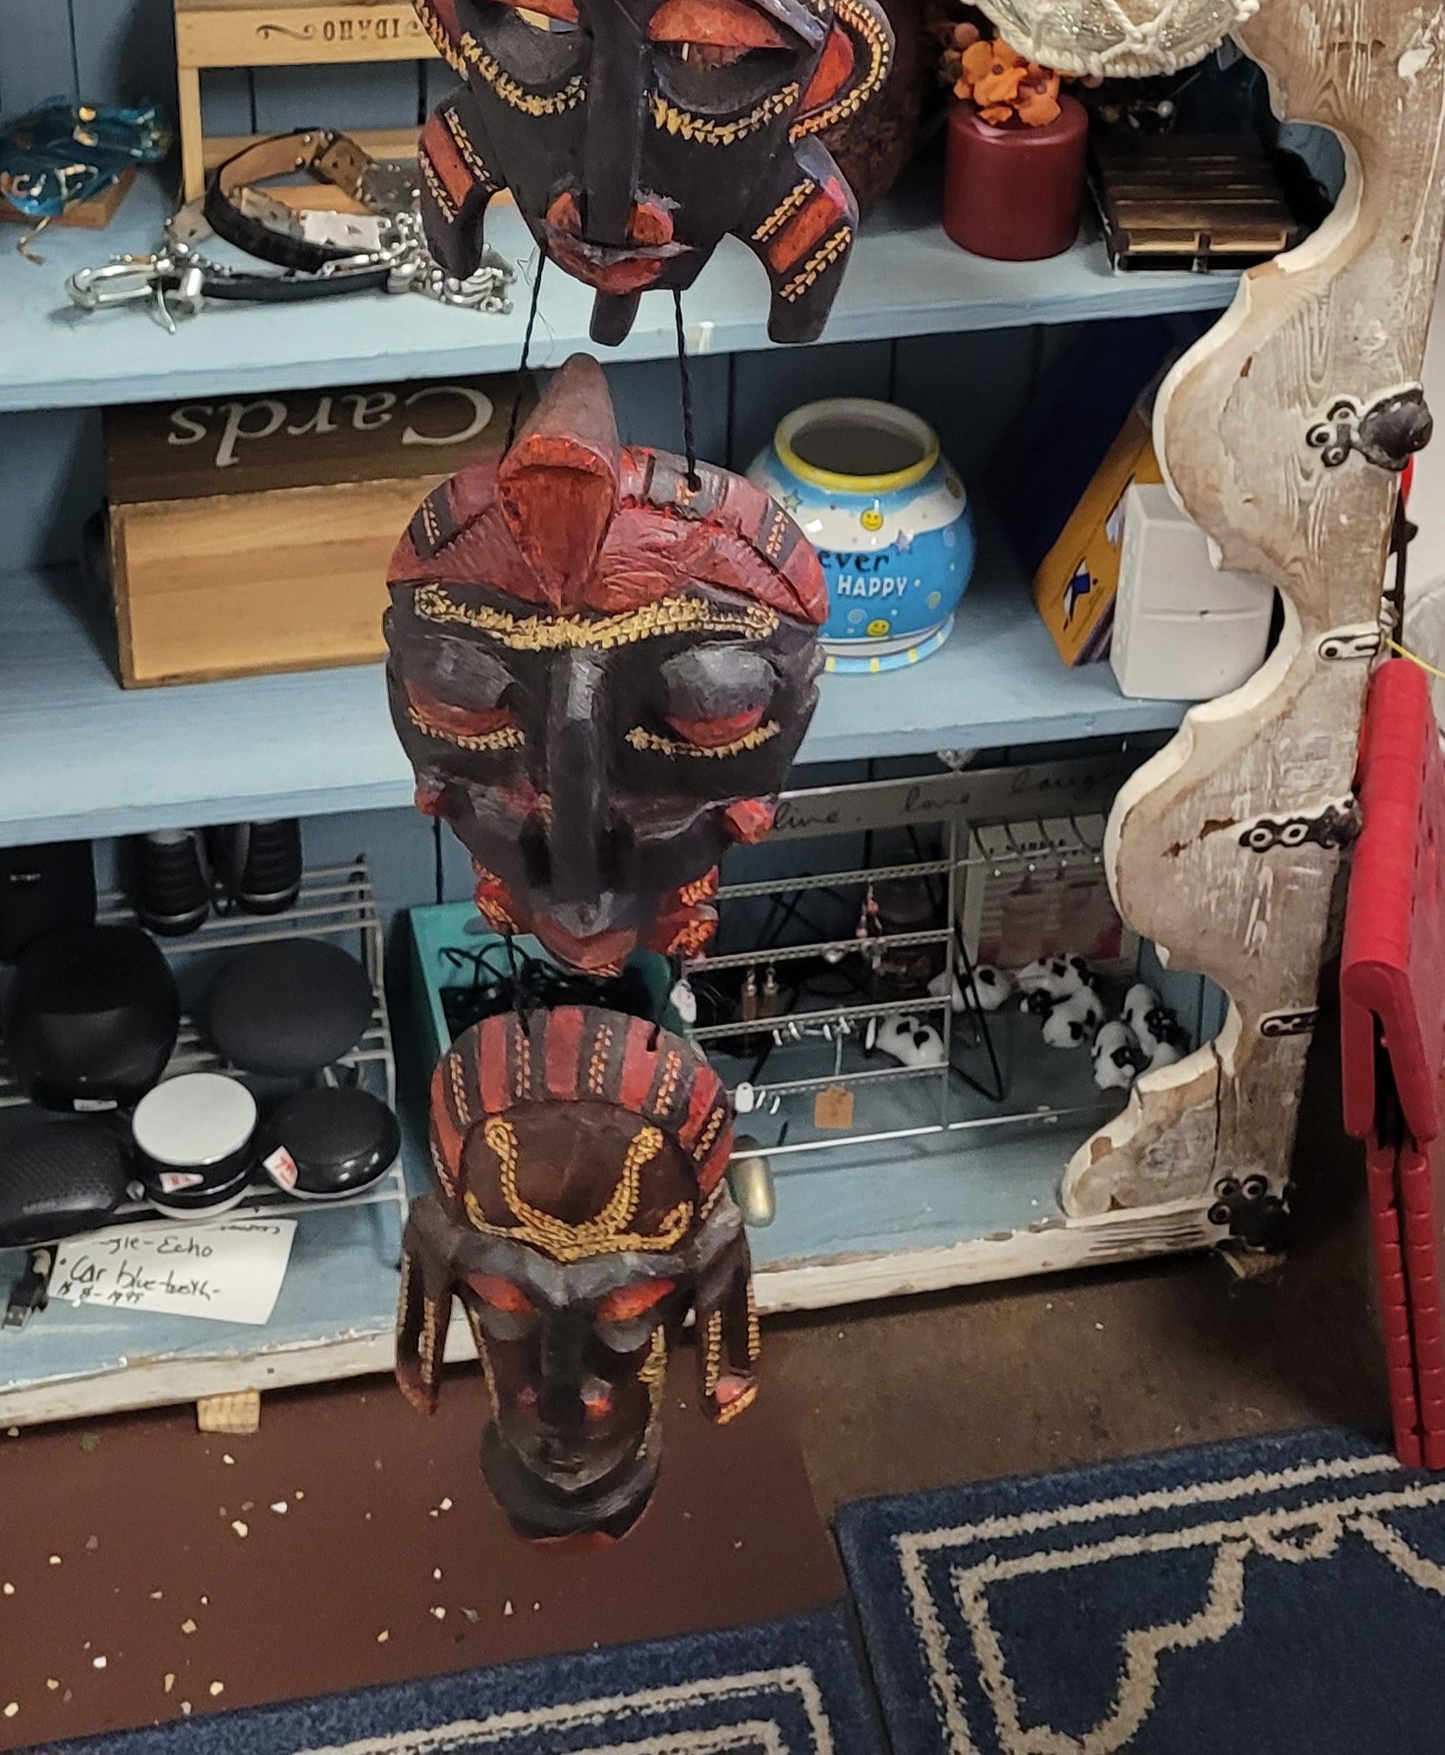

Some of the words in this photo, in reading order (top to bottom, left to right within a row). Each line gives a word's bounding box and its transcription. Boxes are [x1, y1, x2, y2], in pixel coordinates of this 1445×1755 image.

[323, 17, 400, 42] IDAHO
[167, 385, 494, 468] Cards
[837, 573, 908, 597] HAPPY
[70, 1255, 107, 1284] Car
